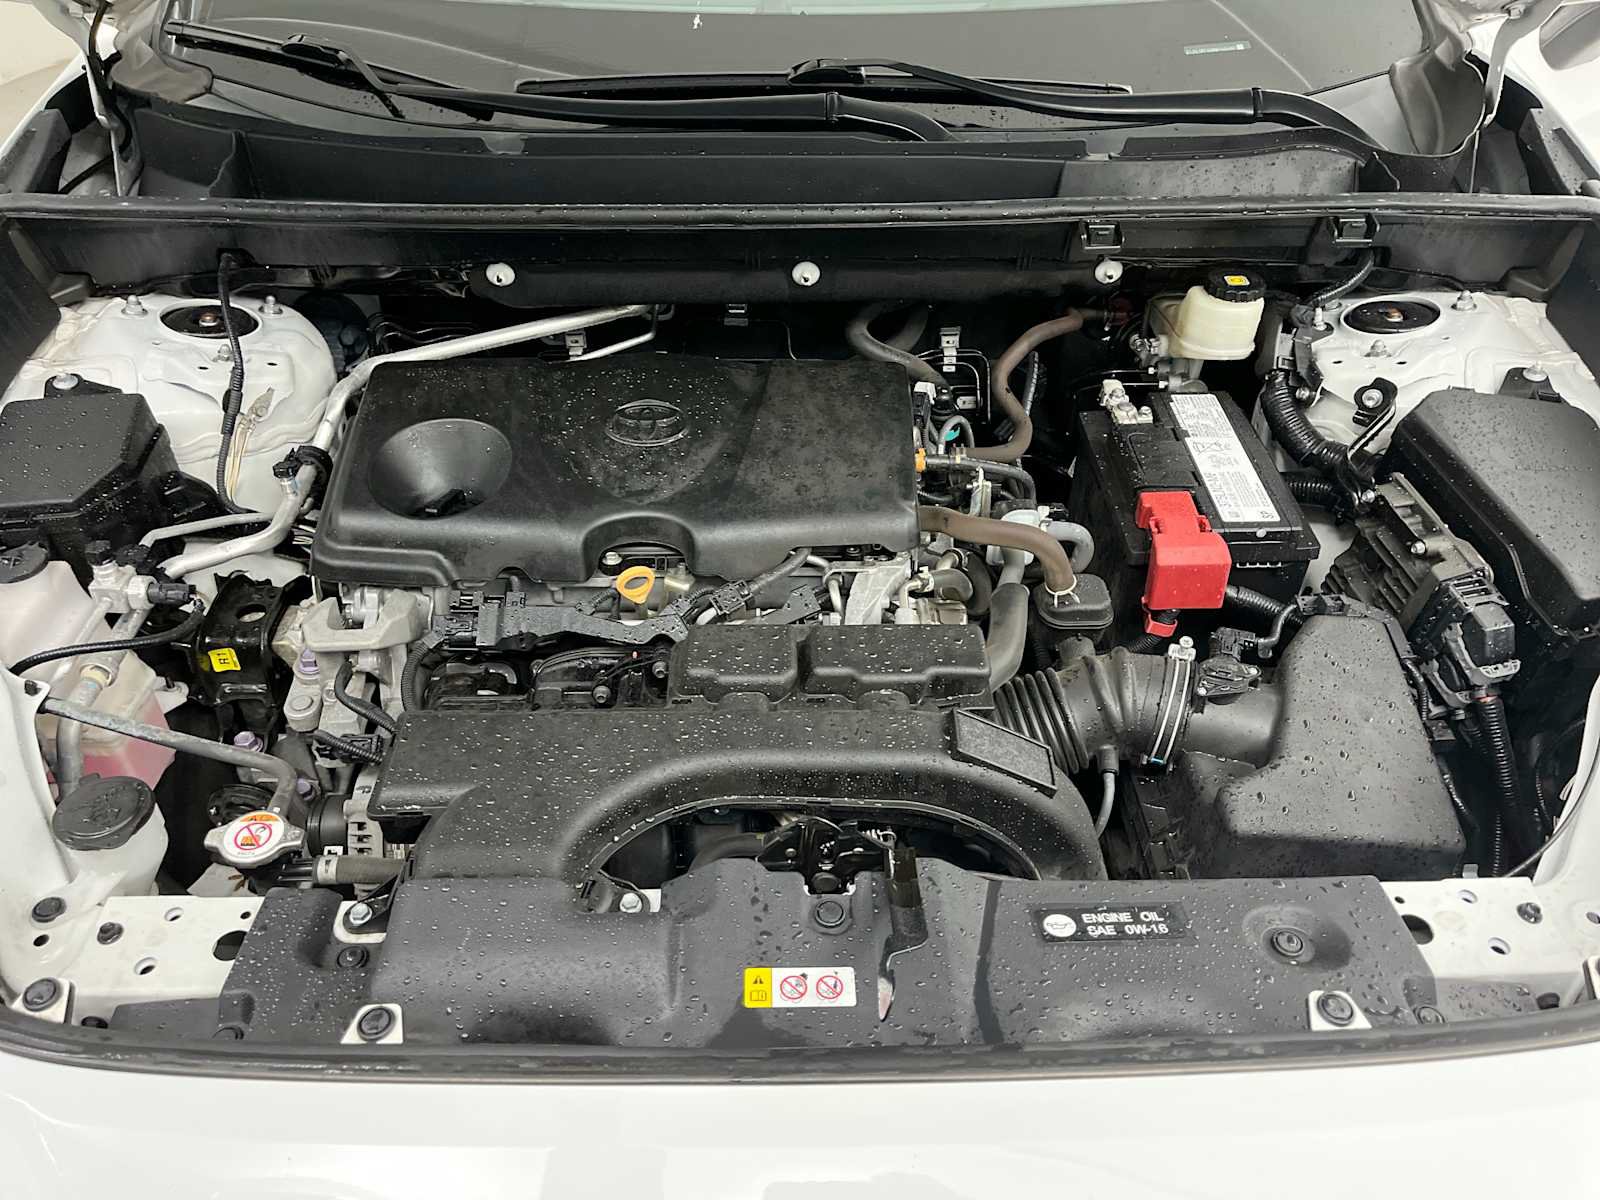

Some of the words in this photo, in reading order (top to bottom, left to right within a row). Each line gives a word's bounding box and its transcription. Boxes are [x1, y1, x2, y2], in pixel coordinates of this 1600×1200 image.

[1081, 912, 1134, 923] ENGINE
[1140, 911, 1164, 922] OIL
[1087, 925, 1117, 936] SAE
[1124, 924, 1169, 935] 0W-16
